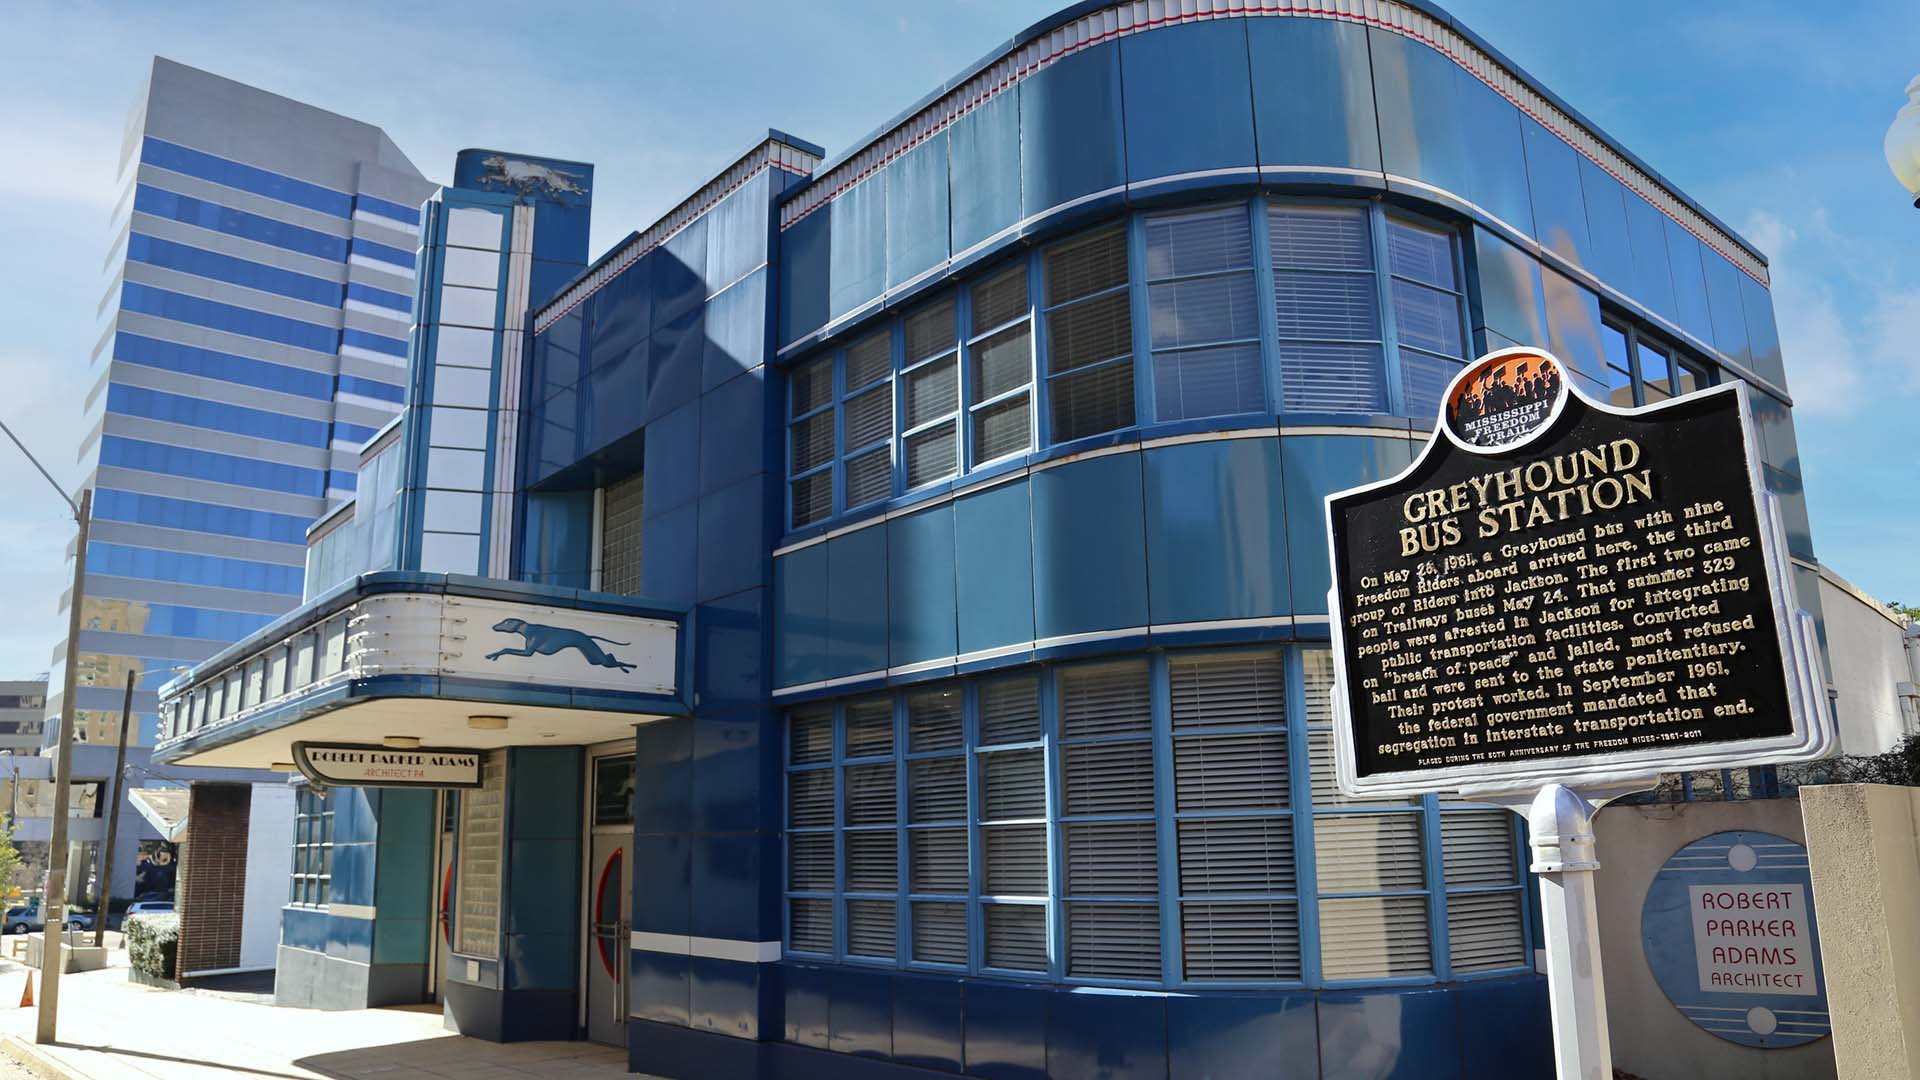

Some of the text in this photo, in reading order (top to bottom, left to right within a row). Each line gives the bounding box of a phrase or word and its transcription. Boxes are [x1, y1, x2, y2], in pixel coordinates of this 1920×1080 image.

[1465, 399, 1548, 431] MISSISSIPPI
[1474, 411, 1540, 437] FREEDOM
[1487, 424, 1529, 444] TRAIL
[1404, 438, 1640, 523] GREYHOUND
[1399, 469, 1653, 557] BUS STATION
[1356, 515, 1733, 607] Freedom Riders aboard arrived here, the third
[1361, 576, 1378, 589] On
[1384, 569, 1410, 585] May
[1483, 551, 1493, 563] a
[1501, 528, 1586, 558] Greyhound
[1594, 522, 1624, 539] bus
[1634, 510, 1673, 529] with
[1684, 500, 1724, 519] nine
[1350, 536, 1750, 627] group of Riders into Jackson. The first two came
[1363, 556, 1736, 638] on Trailways buses May 24. That summer 329
[1358, 576, 1750, 659] people were arrested in Jackson for integrating
[1382, 600, 1720, 670] public transportation facilities. Convicted
[1363, 677, 1378, 688] on
[1528, 647, 1557, 664] and
[1567, 637, 1621, 660] jailed,
[1630, 628, 1673, 648] most
[1684, 615, 1755, 639] refused
[1372, 640, 1746, 704] bail and were sent to the state penitentiary.
[1388, 660, 1730, 719] Their protest worked. In September 1961,
[1399, 683, 1718, 735] the federal government mandated that
[1378, 699, 1754, 756] segregation in interstate transportation end.
[1509, 745, 1559, 757] ANNIVERSARY
[1575, 742, 1590, 750] THE
[1594, 737, 1628, 748] FREEDOM
[312, 751, 475, 767] ROBERT PARKER ADAMS
[364, 768, 411, 777] ARCHITECT
[1702, 891, 1792, 910] ROBERT
[1706, 919, 1796, 937] PARKER
[1711, 972, 1803, 988] ARCHITECT
[1712, 946, 1797, 965] ADAMS
